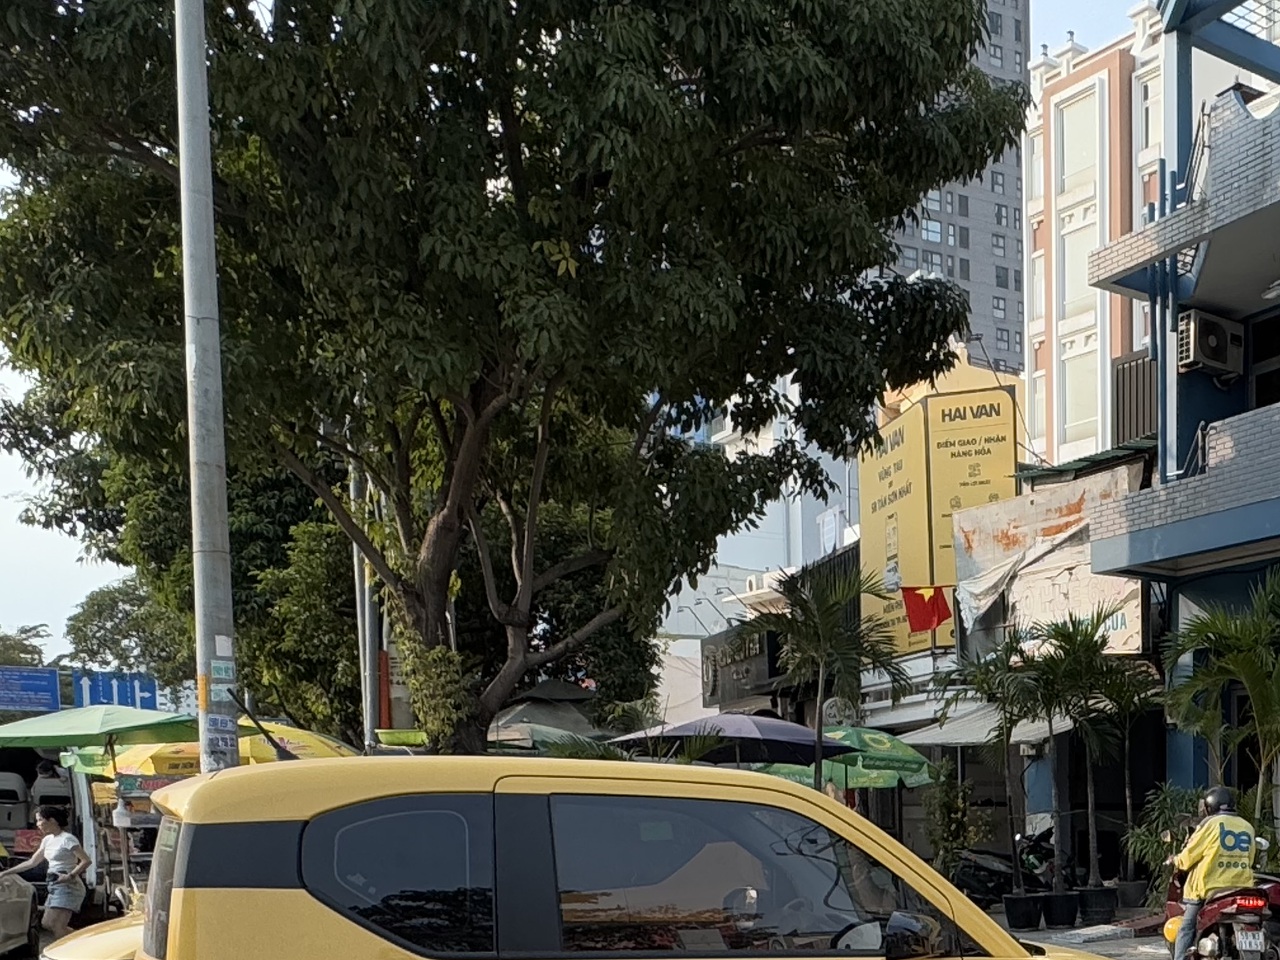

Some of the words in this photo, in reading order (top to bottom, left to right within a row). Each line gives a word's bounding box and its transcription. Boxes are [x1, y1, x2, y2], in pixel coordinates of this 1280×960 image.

[941, 406, 967, 423] HAI
[969, 403, 1001, 419] VAN
[1219, 821, 1252, 852] be
